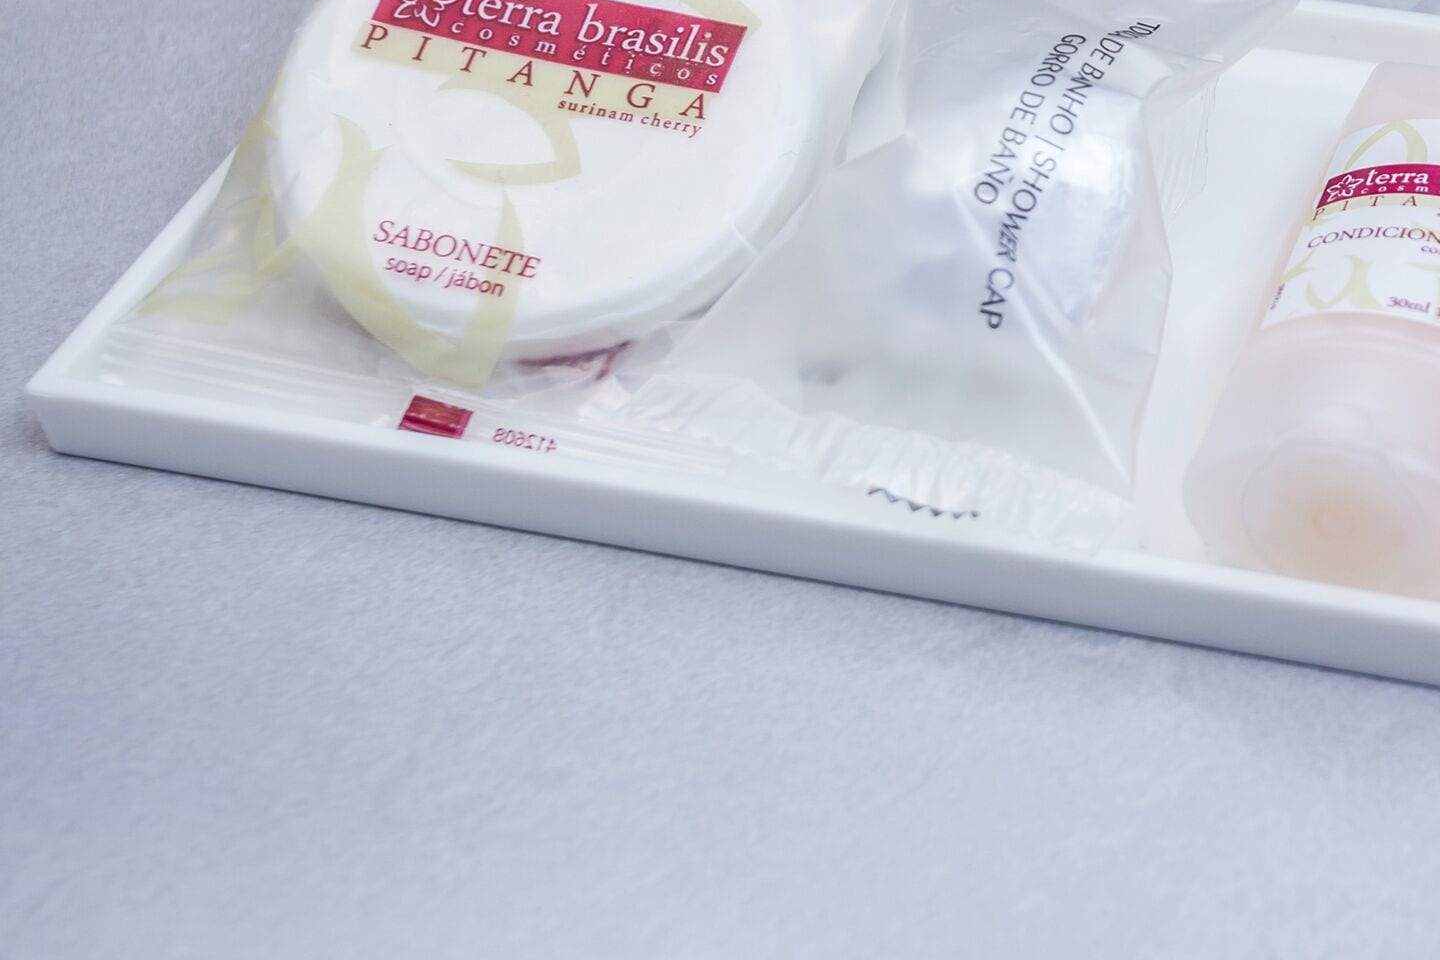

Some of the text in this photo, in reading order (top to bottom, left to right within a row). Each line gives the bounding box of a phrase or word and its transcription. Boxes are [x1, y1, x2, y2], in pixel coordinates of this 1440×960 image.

[451, 21, 718, 85] cosméticos
[577, 3, 729, 67] brasilis
[1089, 37, 1124, 66] DE
[361, 24, 706, 120] PITANGA
[1050, 62, 1105, 135] BANHO
[558, 100, 702, 138] surinam cherry
[974, 34, 1086, 204] GORRO DE BAÑO
[997, 151, 1057, 262] SHOWER
[1366, 169, 1429, 186] terra
[373, 220, 541, 278] SABONETE
[385, 257, 432, 281] soap
[444, 269, 505, 296] jábon
[980, 268, 1014, 329] CAP
[1387, 296, 1431, 313] 30ml
